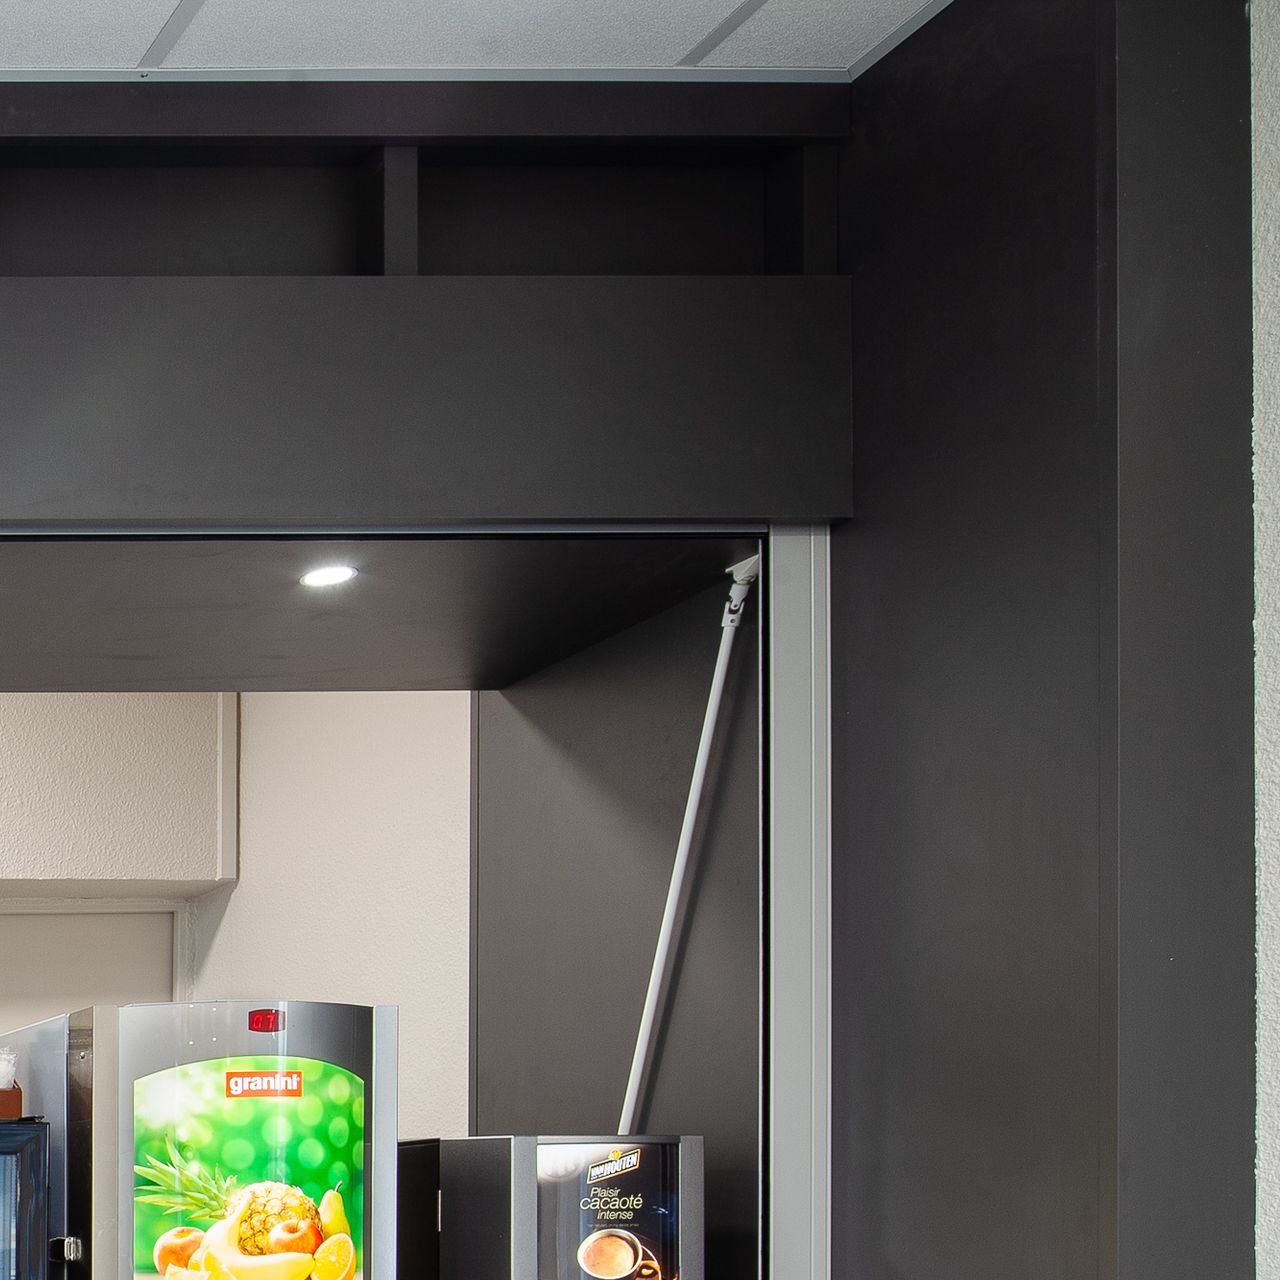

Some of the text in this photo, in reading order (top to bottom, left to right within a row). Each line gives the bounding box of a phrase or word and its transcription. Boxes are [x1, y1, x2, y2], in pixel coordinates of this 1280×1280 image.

[229, 1073, 299, 1096] granini
[603, 1153, 638, 1175] HOUTEN
[591, 1186, 621, 1198] Plaisir
[580, 1193, 643, 1210] cacaoté
[597, 1209, 634, 1220] intense
